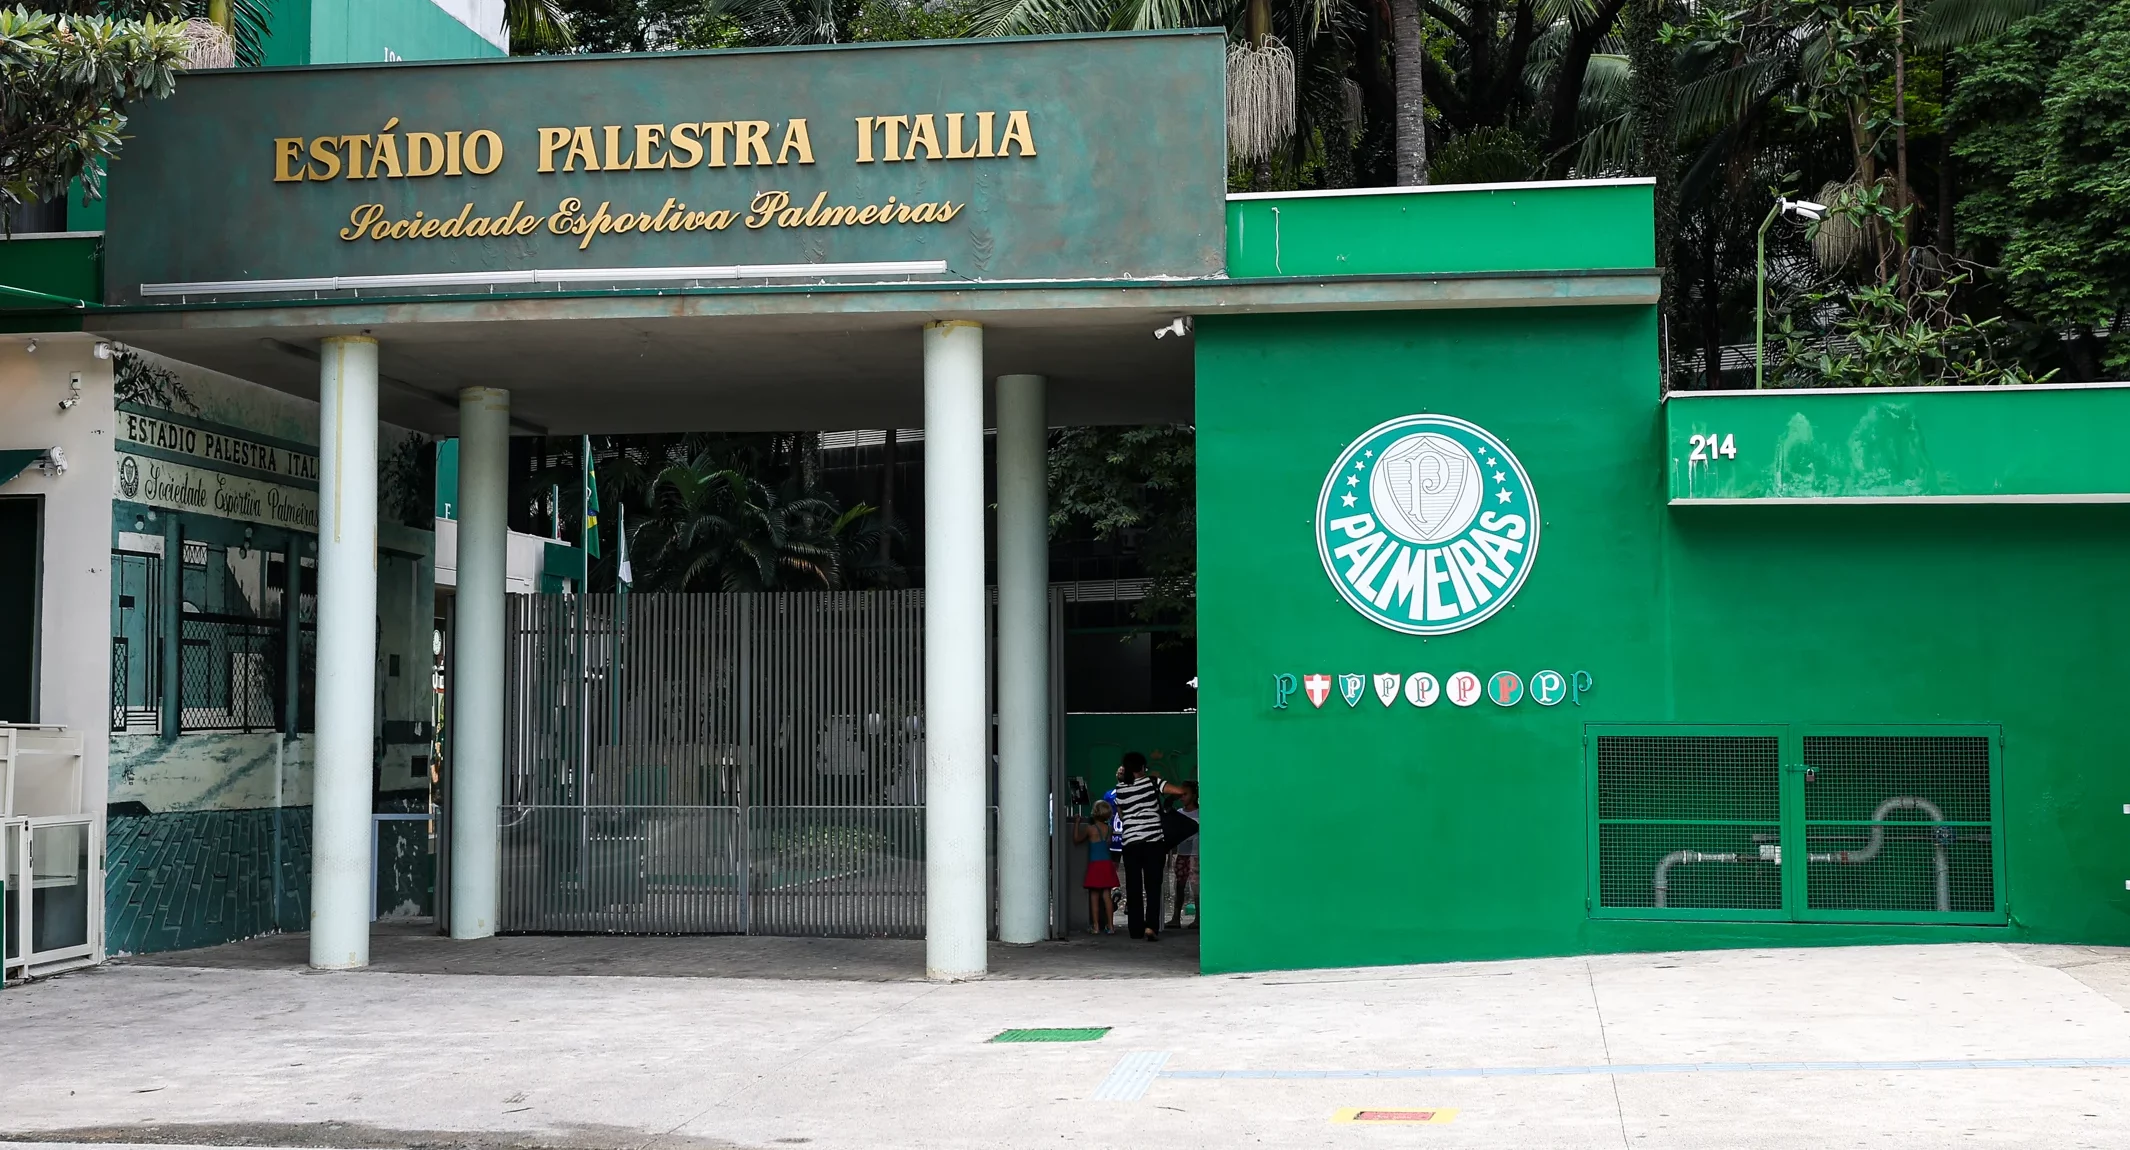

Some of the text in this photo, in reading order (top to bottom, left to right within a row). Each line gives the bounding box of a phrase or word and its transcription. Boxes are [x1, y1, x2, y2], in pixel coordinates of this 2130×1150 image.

[273, 110, 1037, 183] ESTÁDIO PALESTRA ITALIA
[340, 190, 965, 250] Sociedade Esportiva Palmeiras
[205, 433, 277, 472] PALESTRA
[1689, 433, 1737, 460] 214
[144, 464, 208, 508] Sociedade
[214, 472, 262, 518] Esportiva
[267, 487, 319, 527] Palmeiras
[1330, 511, 1526, 621] PALMEIRAS
